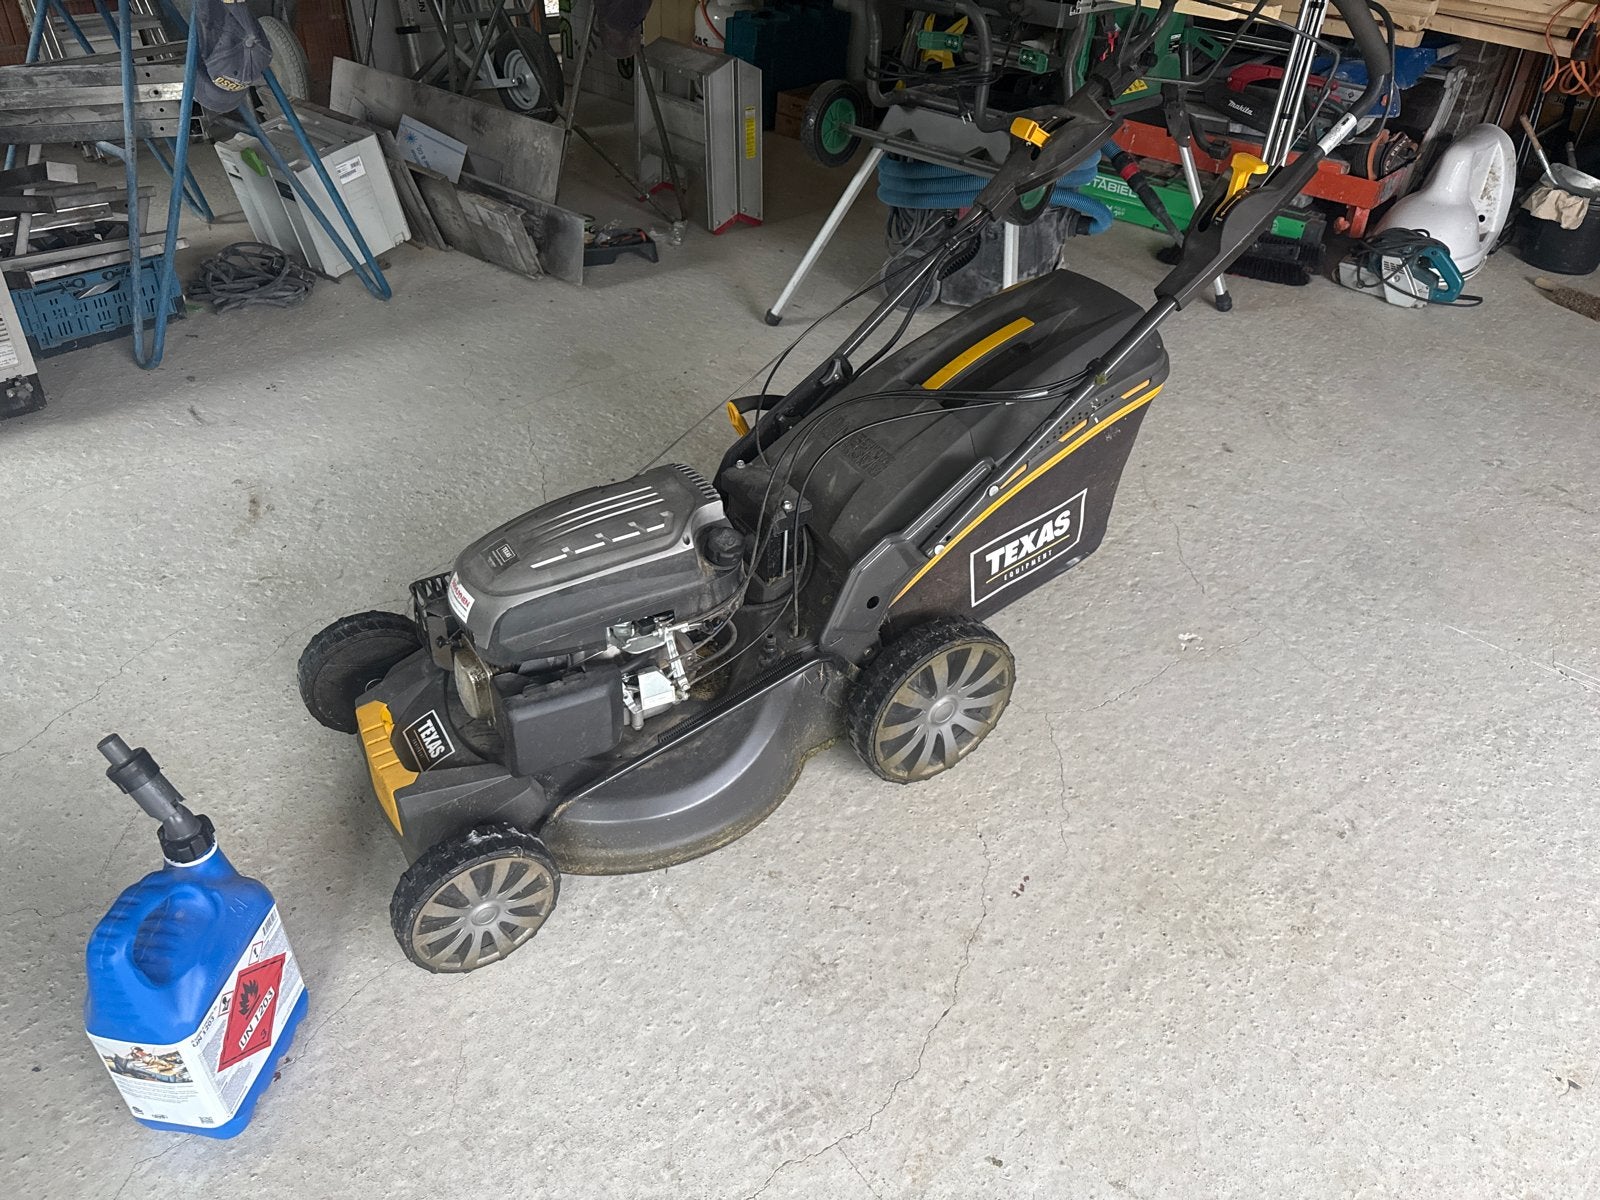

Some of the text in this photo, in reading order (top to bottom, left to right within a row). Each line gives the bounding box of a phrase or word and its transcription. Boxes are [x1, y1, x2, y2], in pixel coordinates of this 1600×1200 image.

[985, 509, 1071, 576] TEXAS
[1003, 549, 1053, 581] EQUIPMENT
[417, 719, 445, 759] TEXAS
[239, 990, 274, 1047] UN 1203
[261, 1029, 268, 1040] 3
